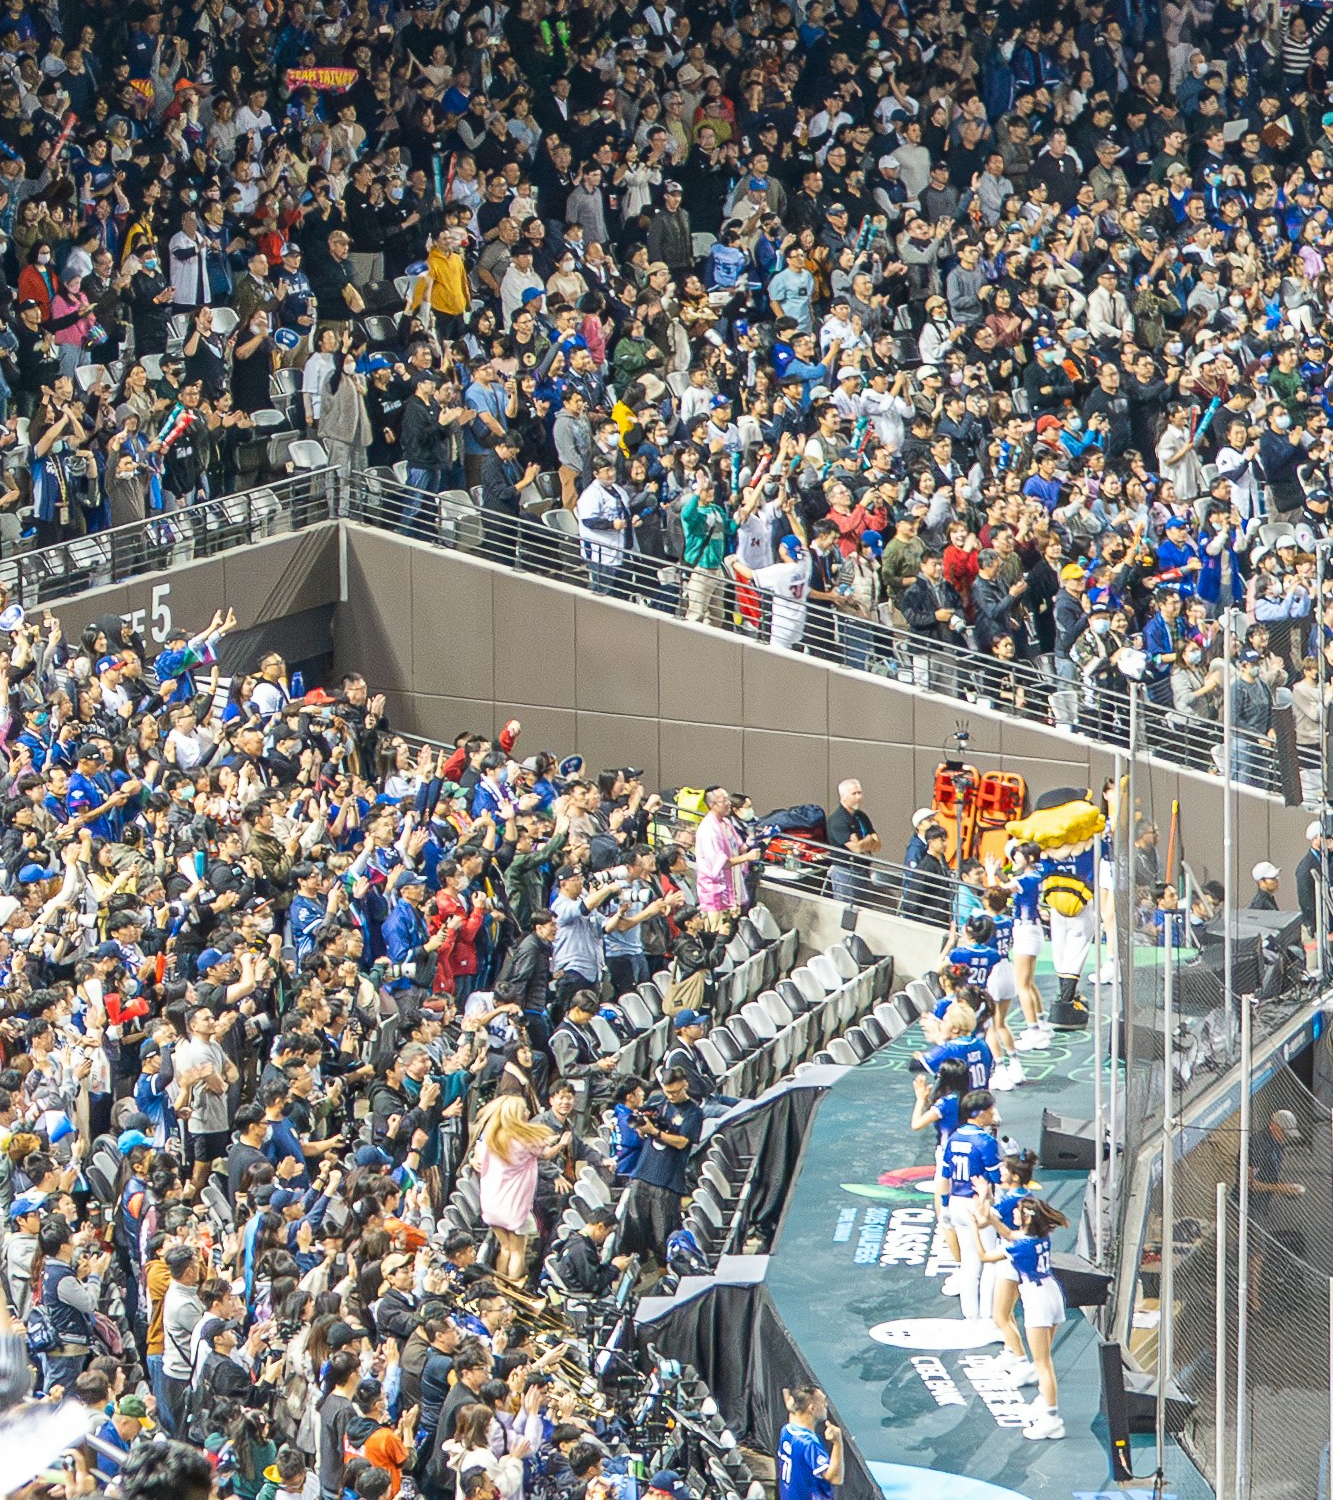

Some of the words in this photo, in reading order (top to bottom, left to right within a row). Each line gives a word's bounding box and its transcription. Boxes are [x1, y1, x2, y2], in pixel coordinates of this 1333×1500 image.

[150, 583, 173, 644] 5
[967, 967, 988, 984] 20
[968, 1062, 987, 1089] 10
